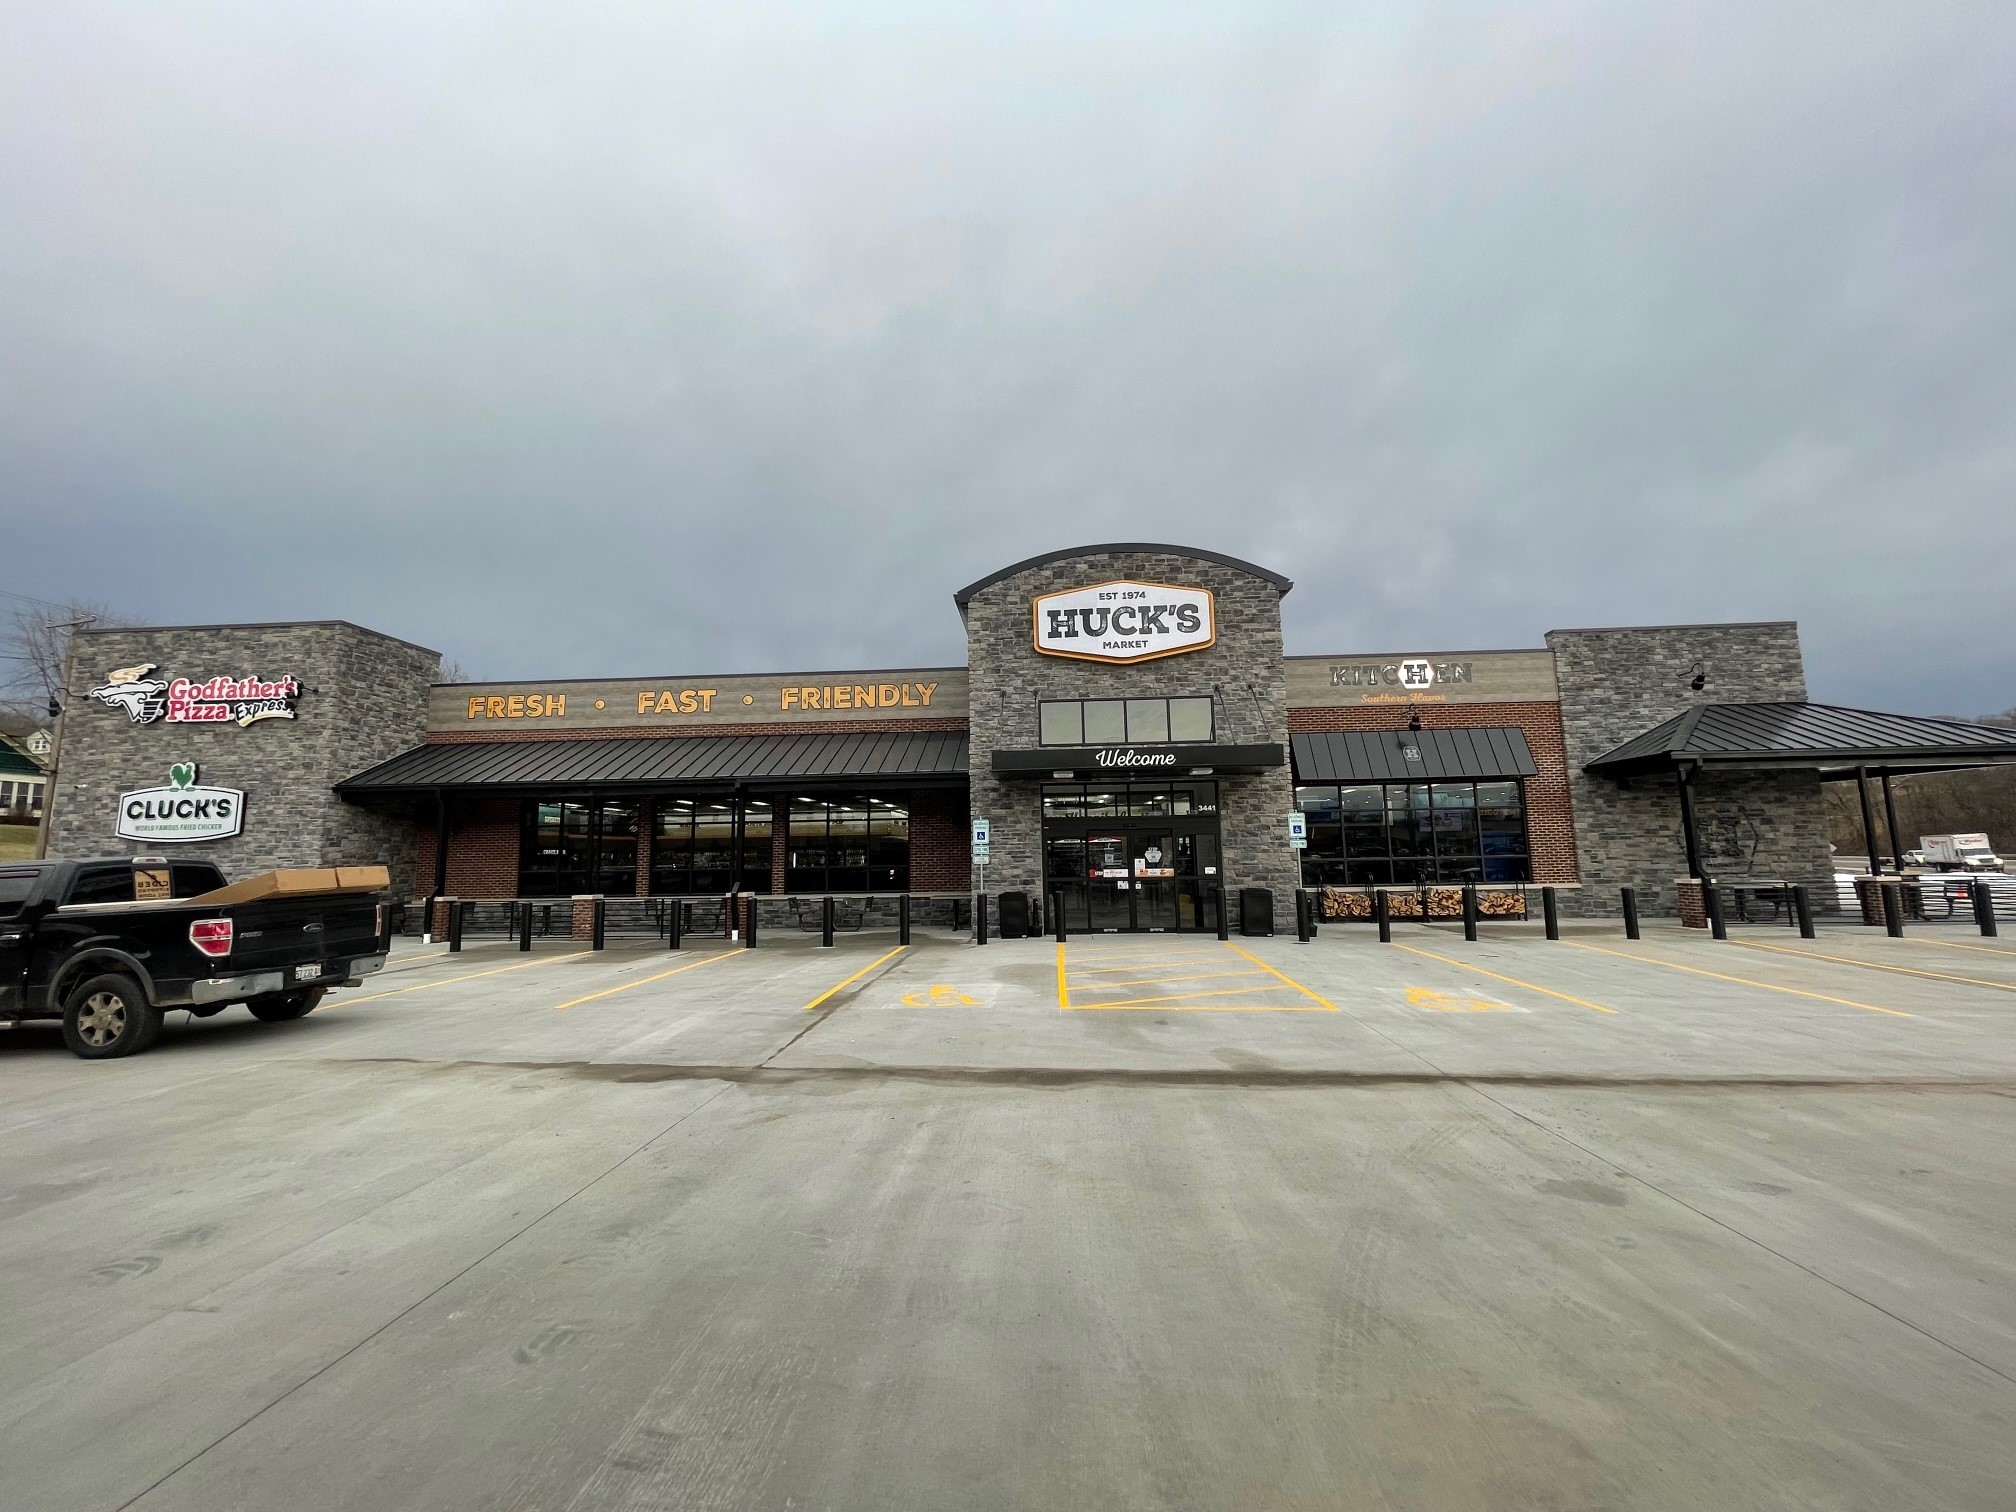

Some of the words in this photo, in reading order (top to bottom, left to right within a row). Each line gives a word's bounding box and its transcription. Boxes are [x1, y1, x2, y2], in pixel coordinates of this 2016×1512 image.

[1098, 592, 1118, 601] EST
[1122, 591, 1146, 600] 1974
[1047, 603, 1201, 638] HUCK'S
[1102, 640, 1149, 650] MARKET
[1328, 662, 1473, 687] KITCHEN
[467, 694, 566, 719] FRESH
[637, 689, 718, 714] FAST
[780, 682, 939, 710] FRIENDLY
[1360, 693, 1407, 704] Southern
[1409, 692, 1447, 702] Flavor
[167, 700, 230, 720] Pizza
[1095, 748, 1176, 767] Welcome
[126, 798, 232, 820] CLUCK'S
